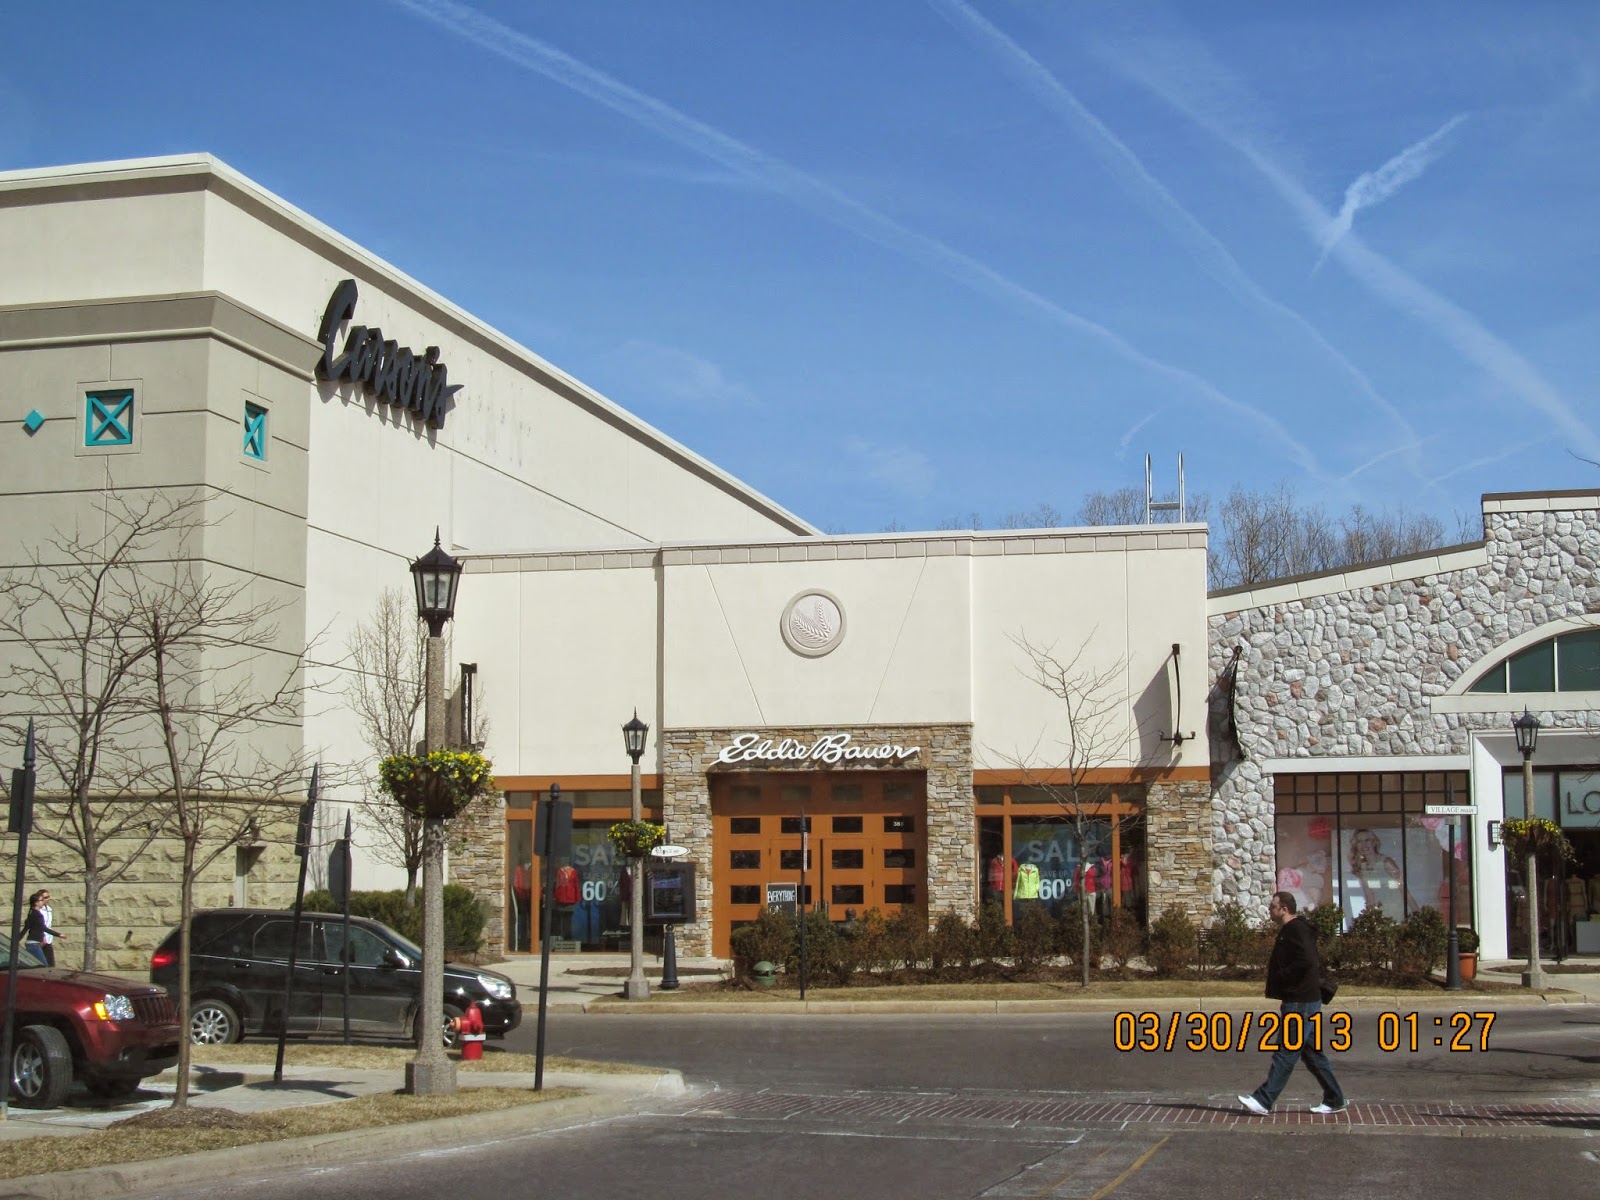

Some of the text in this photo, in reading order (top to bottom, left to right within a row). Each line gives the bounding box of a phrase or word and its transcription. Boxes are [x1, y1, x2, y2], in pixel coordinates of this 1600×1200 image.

[710, 733, 921, 765] Eddie Bauer
[575, 844, 628, 866] SAL
[582, 880, 620, 901] 60%
[768, 890, 795, 903] EVERYTHING
